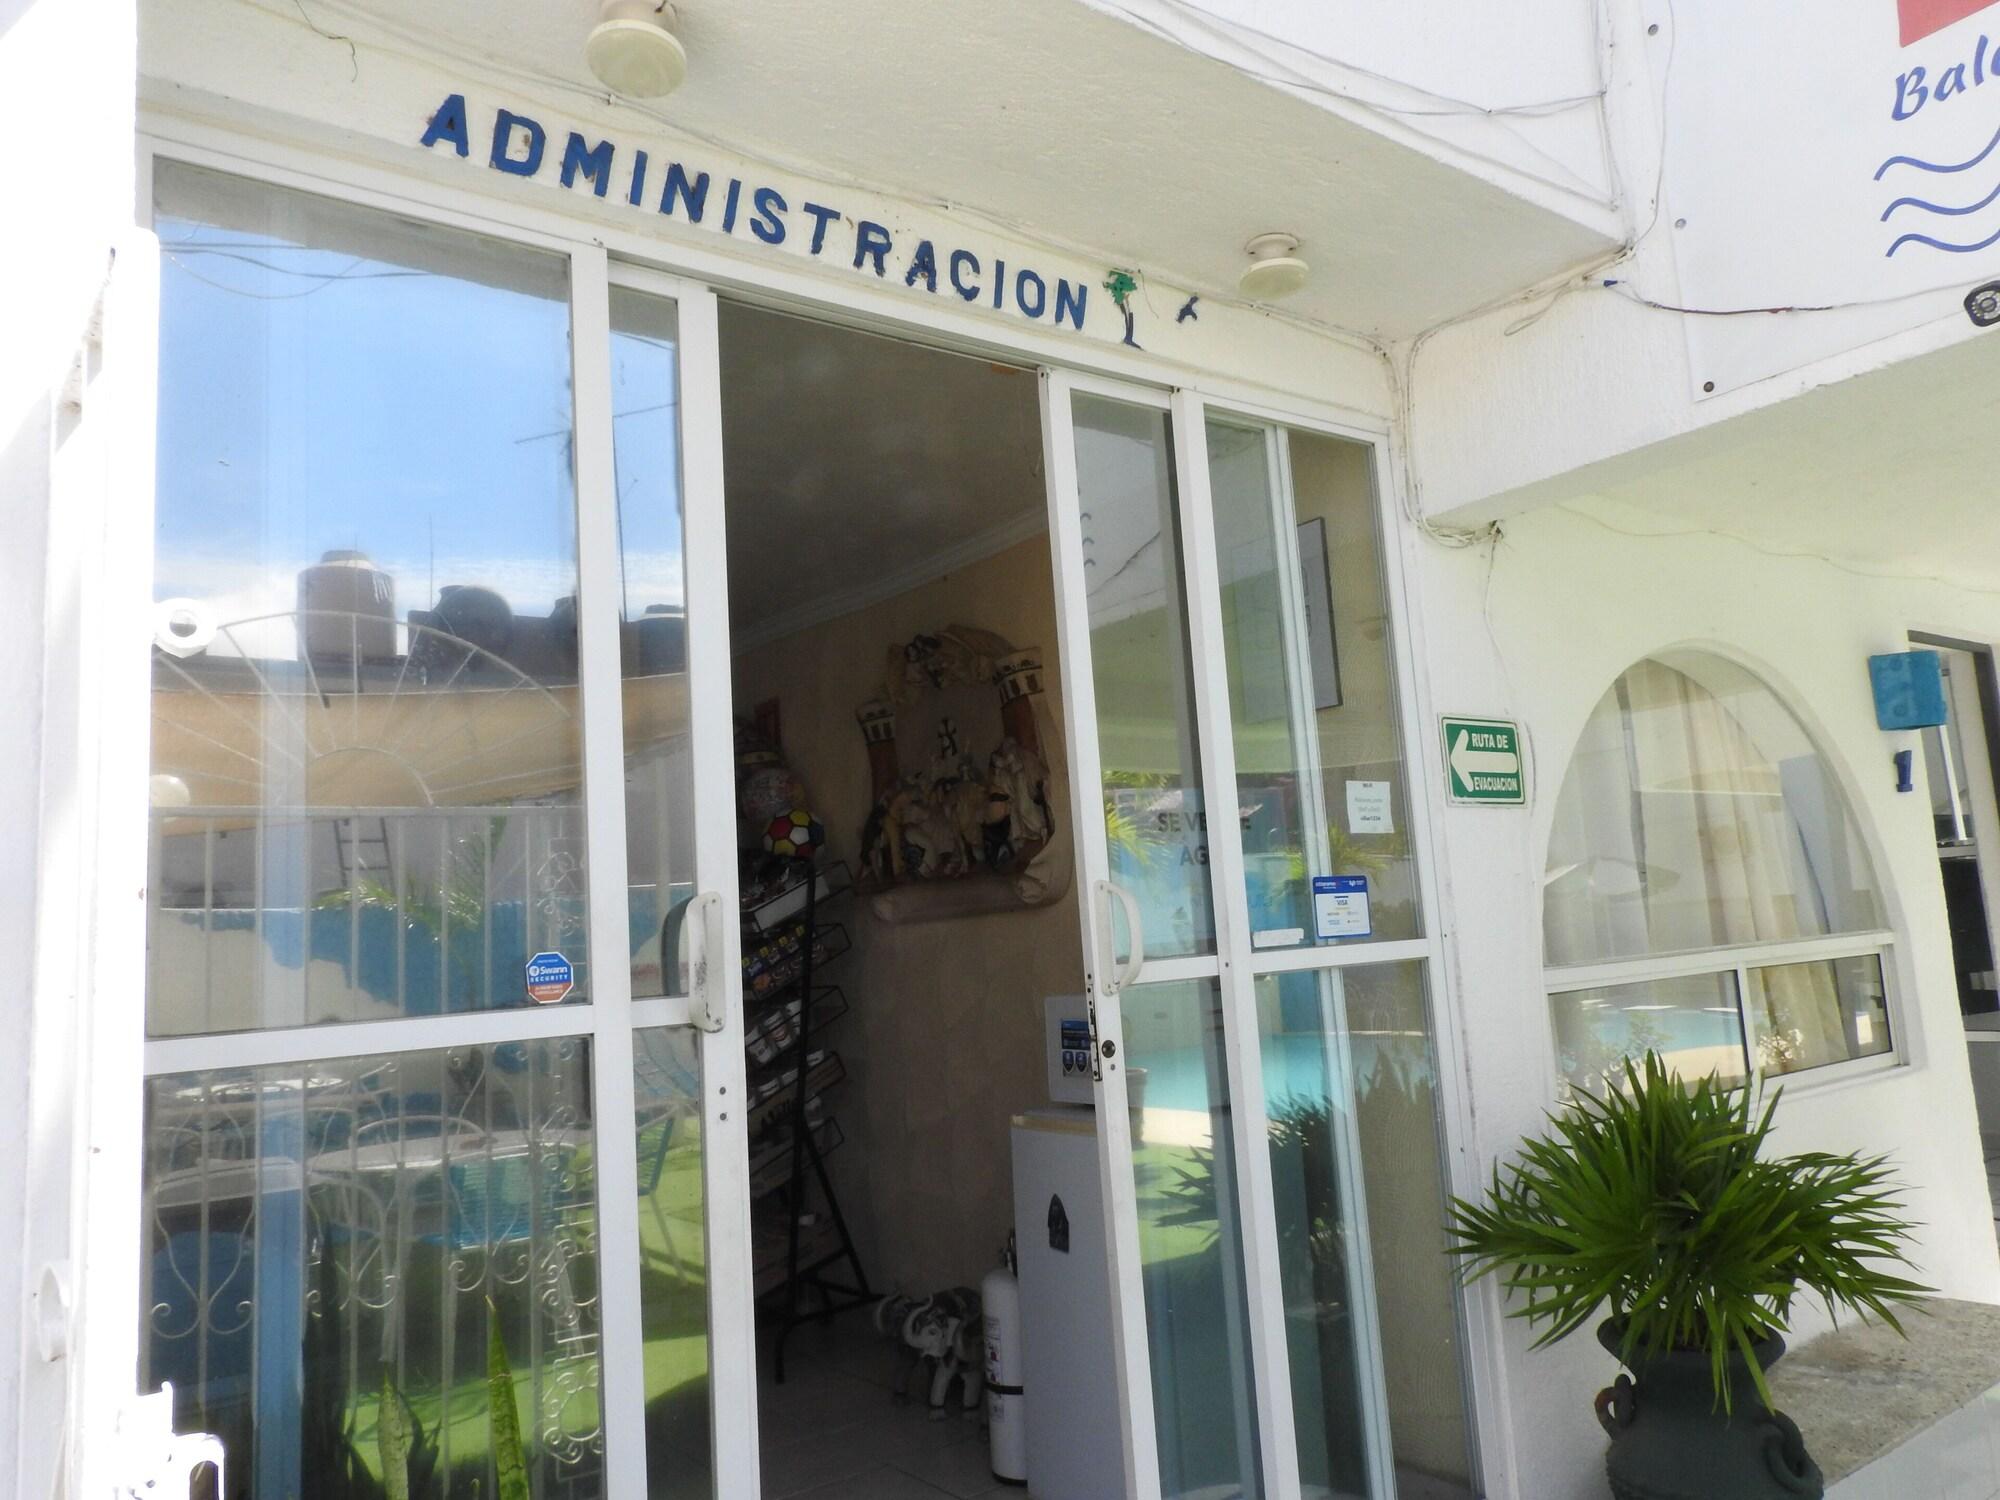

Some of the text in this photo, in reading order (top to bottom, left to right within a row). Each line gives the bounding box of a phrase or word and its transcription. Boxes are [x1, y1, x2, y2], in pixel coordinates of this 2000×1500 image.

[420, 94, 1088, 330] ADMINISTRACION
[1471, 733, 1509, 748] RUTA DE
[1893, 750, 1912, 792] 1
[1473, 777, 1518, 791] EVACUACION
[1158, 812, 1180, 832] SE
